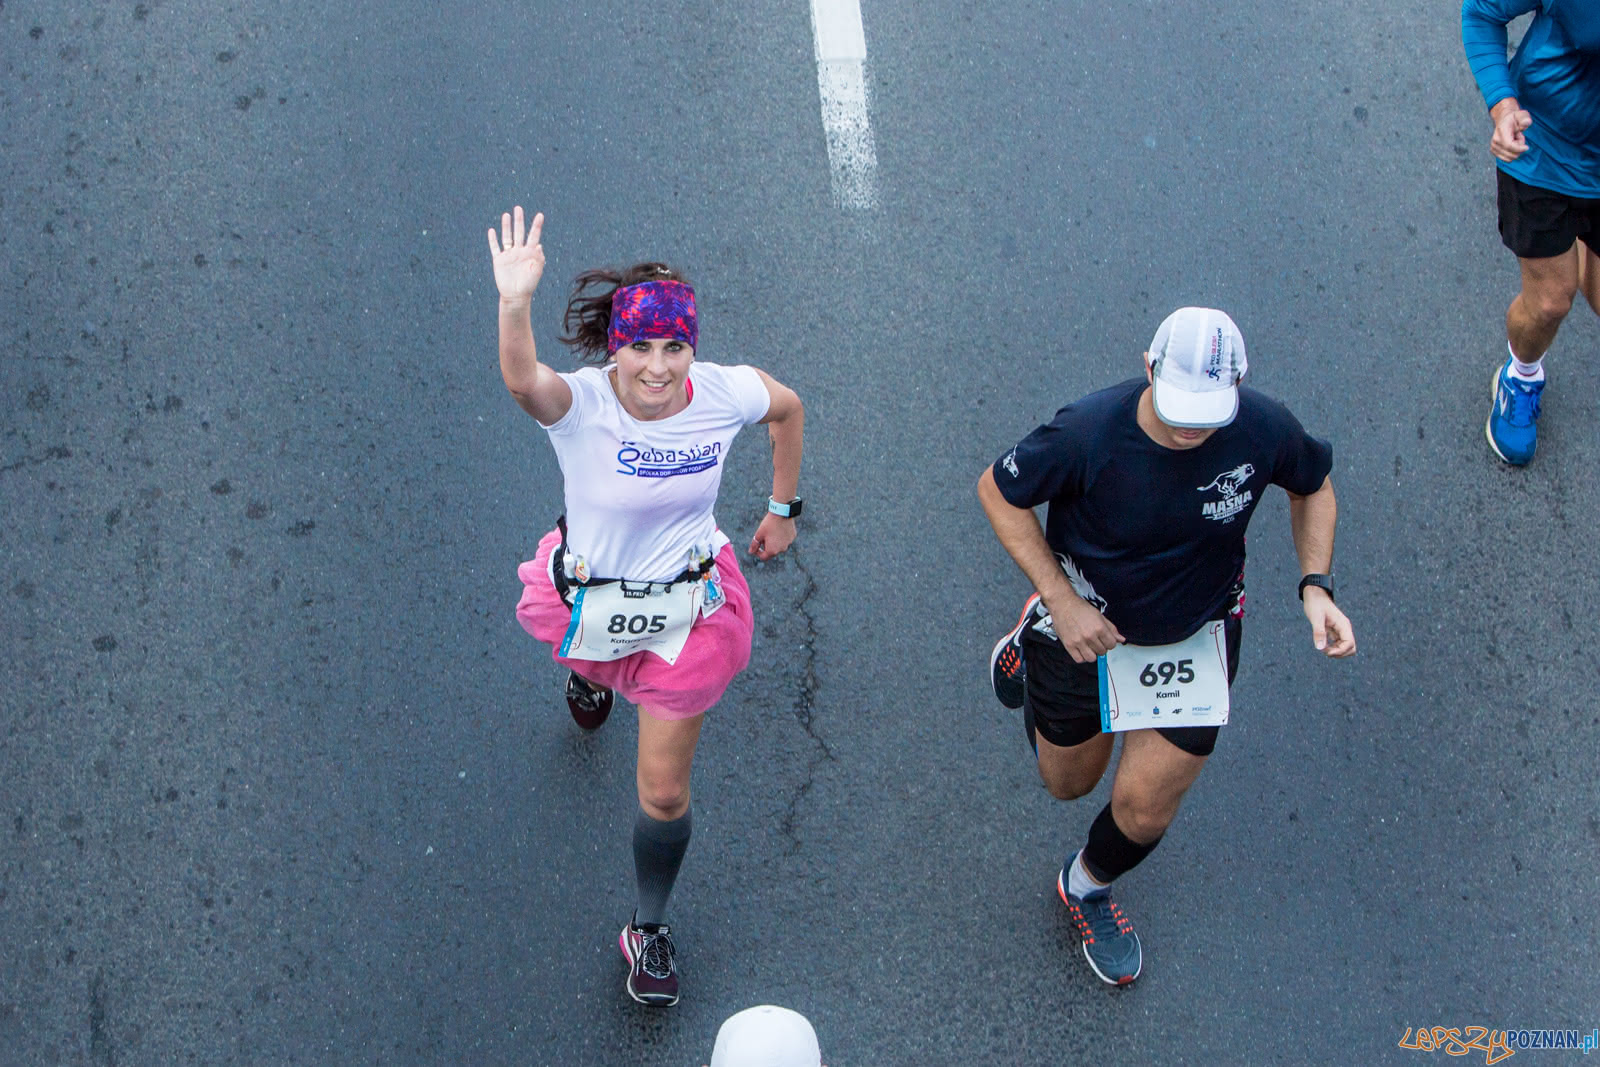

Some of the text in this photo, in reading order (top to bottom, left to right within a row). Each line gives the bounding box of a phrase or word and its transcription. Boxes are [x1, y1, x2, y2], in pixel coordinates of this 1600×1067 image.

[616, 441, 721, 475] Sebastian
[1201, 490, 1253, 515] MASNA
[607, 614, 667, 634] 805
[1139, 659, 1195, 687] 695
[1156, 690, 1180, 699] Kamil
